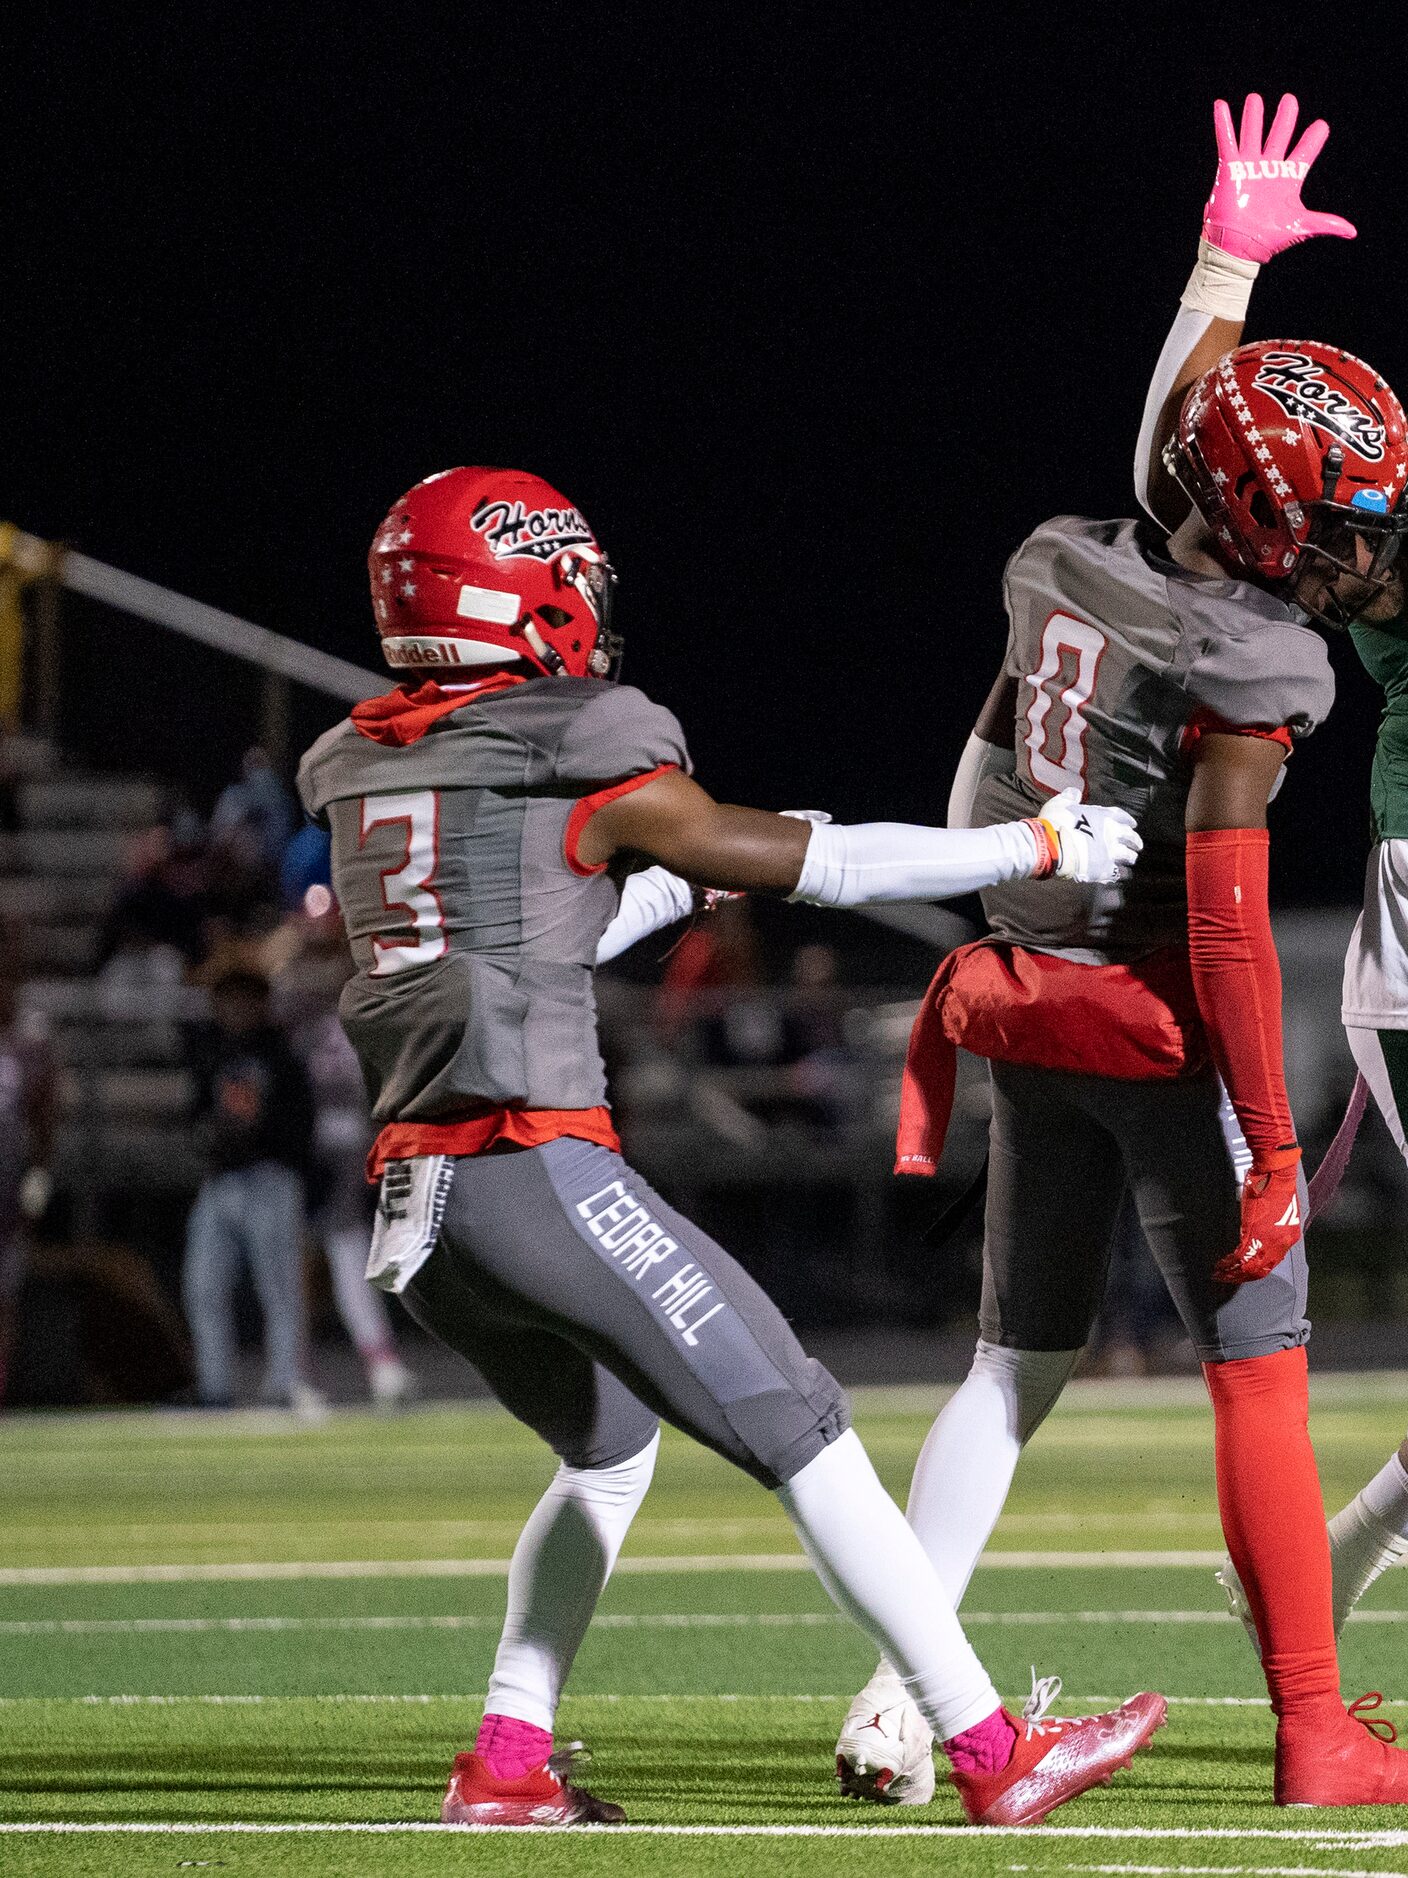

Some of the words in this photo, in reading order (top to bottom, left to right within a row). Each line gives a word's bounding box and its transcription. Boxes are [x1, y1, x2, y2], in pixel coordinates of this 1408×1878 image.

[1254, 351, 1385, 462] Horns
[470, 501, 592, 552] Horn
[1024, 609, 1108, 804] 0
[359, 786, 451, 979] 3
[576, 1181, 678, 1280] CEDAR
[652, 1263, 725, 1346] HILL
